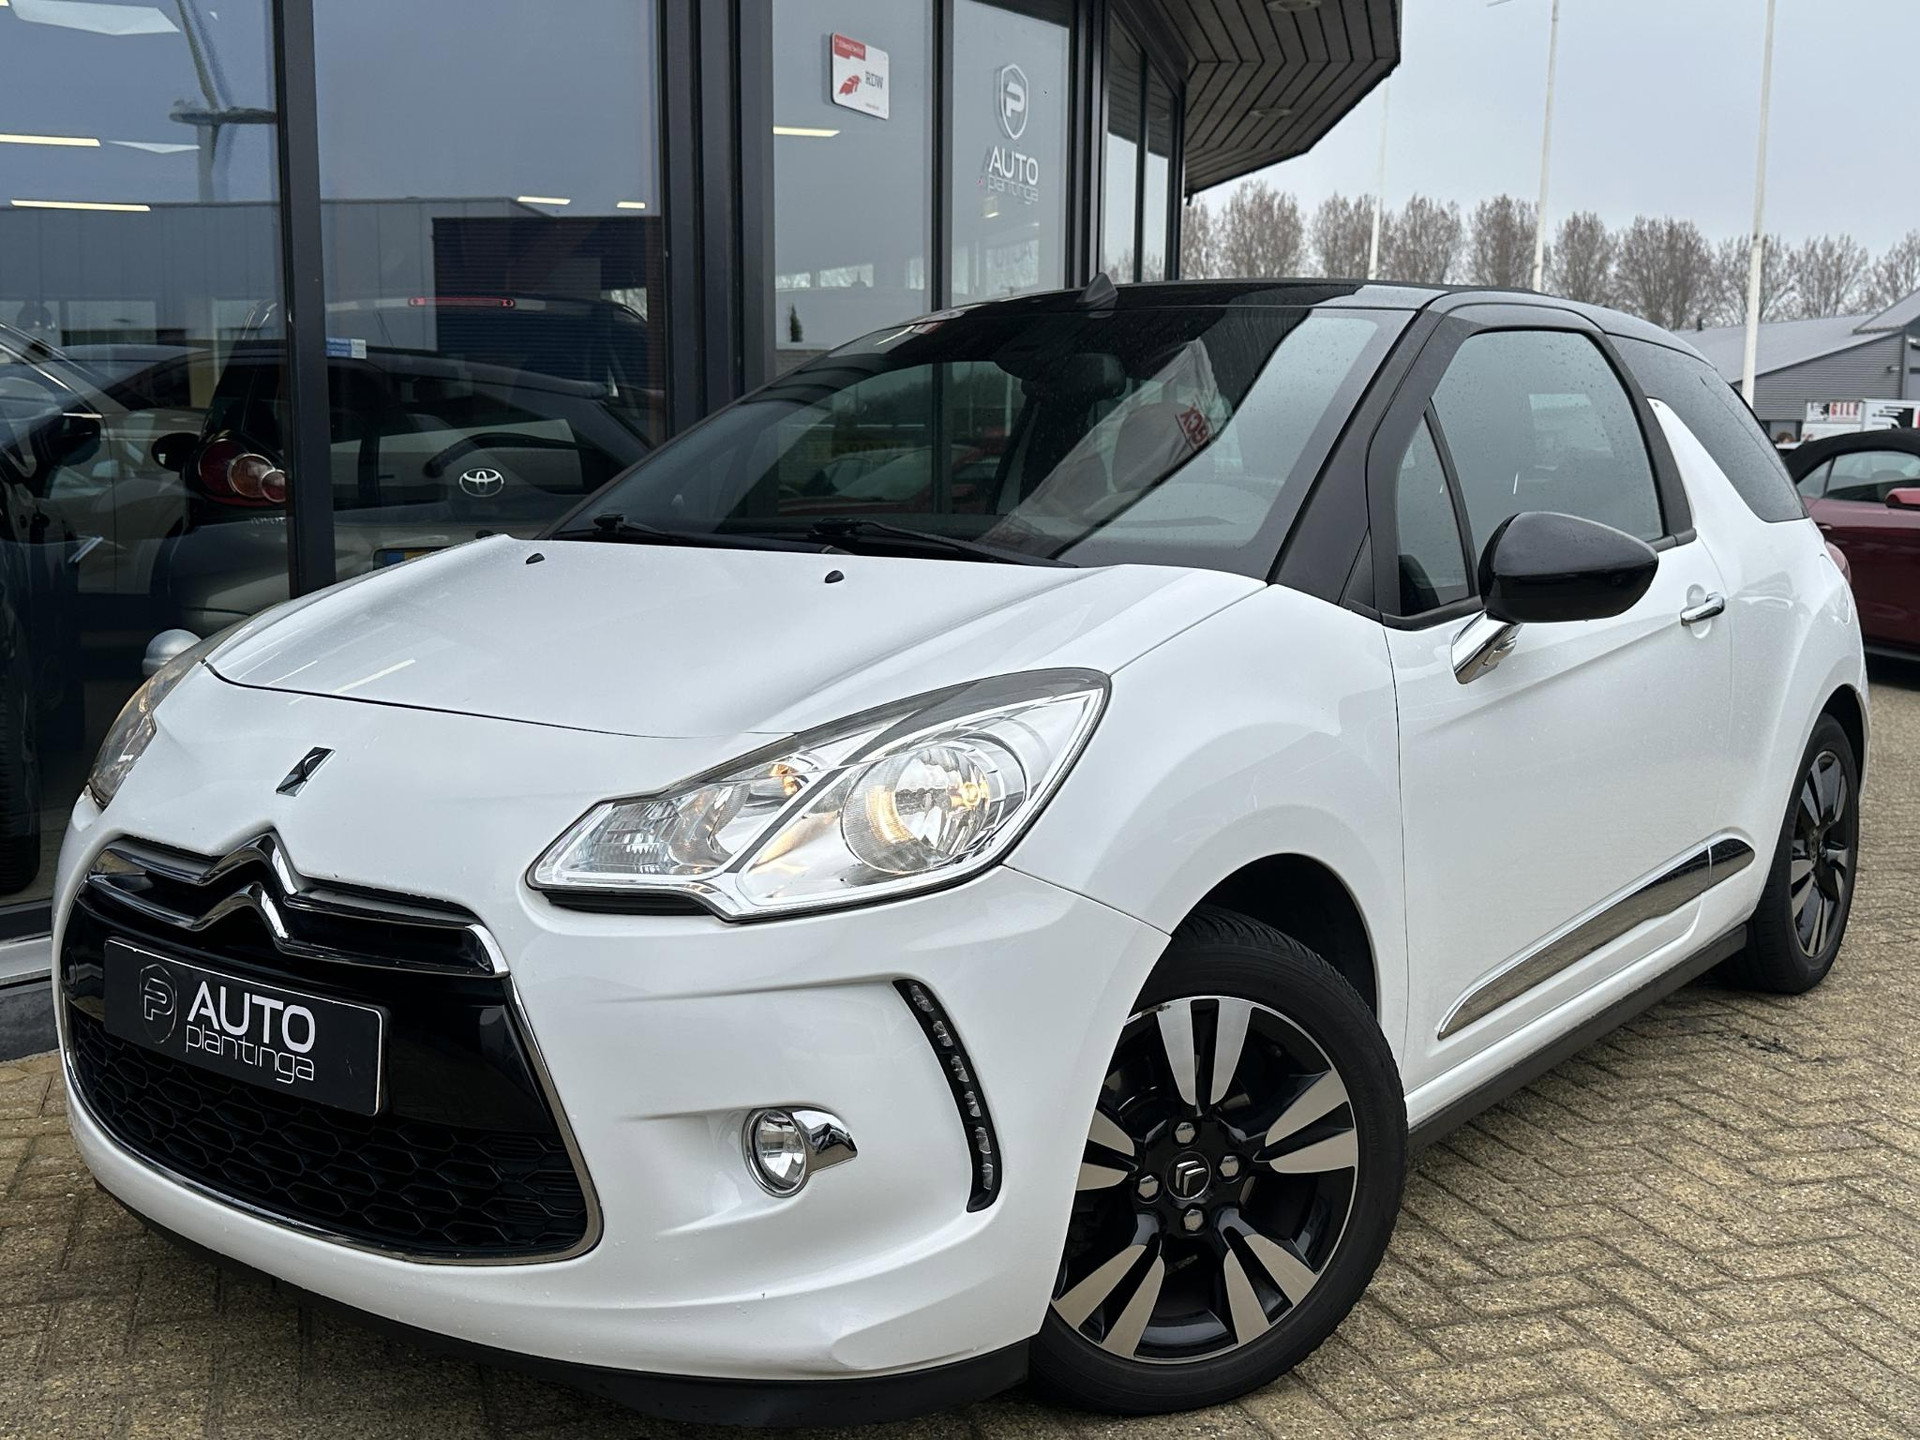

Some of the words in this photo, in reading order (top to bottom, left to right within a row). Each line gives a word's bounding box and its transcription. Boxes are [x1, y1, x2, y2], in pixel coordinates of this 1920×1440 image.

[865, 70, 884, 89] RDW
[988, 145, 1039, 186] AUTO
[186, 980, 316, 1054] AUTO
[186, 1024, 315, 1084] plantinga
